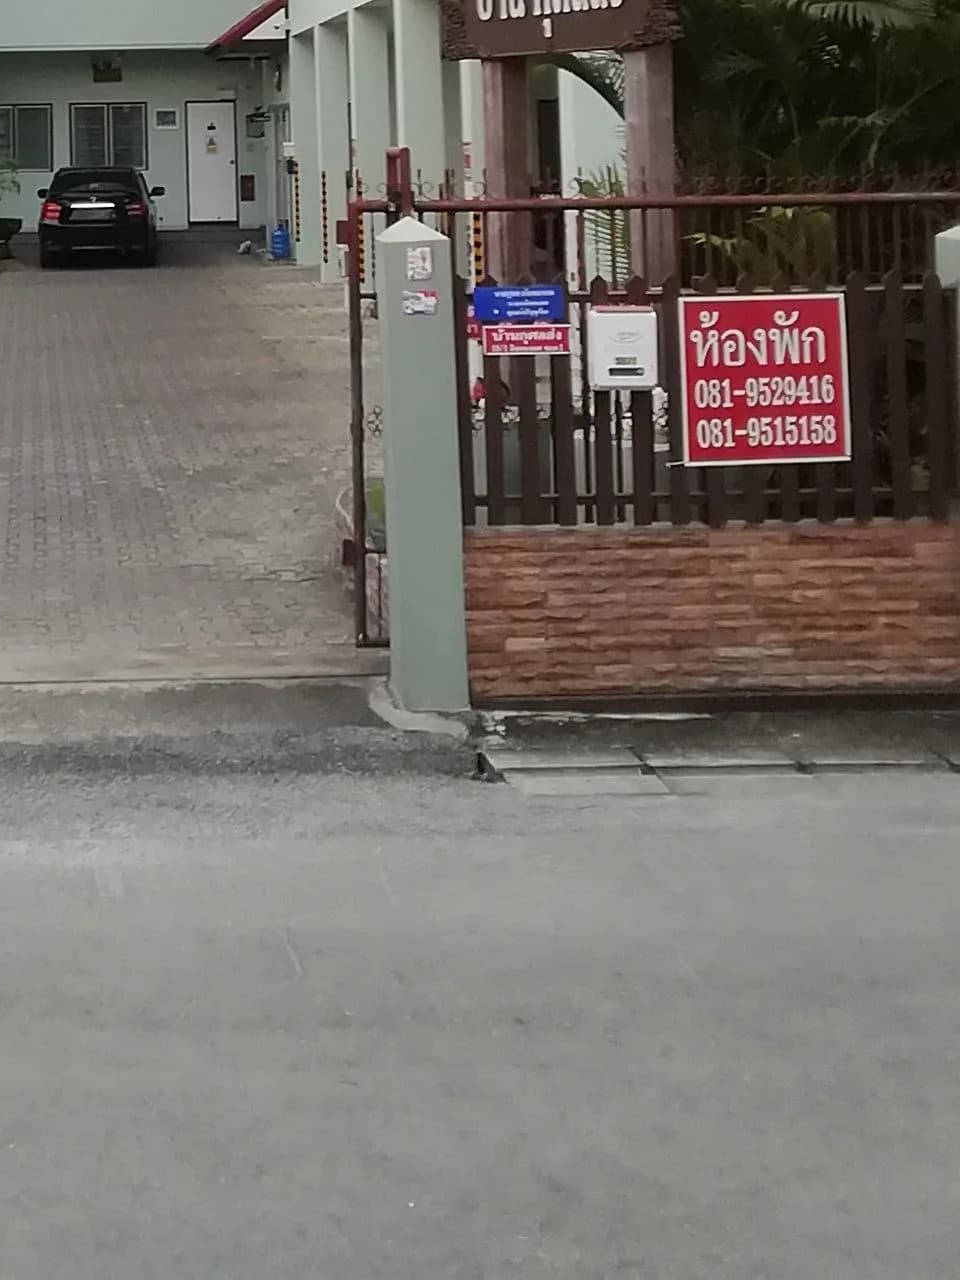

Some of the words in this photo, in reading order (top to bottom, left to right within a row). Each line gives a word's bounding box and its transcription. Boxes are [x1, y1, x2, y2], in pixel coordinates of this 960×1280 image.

[690, 310, 826, 367] ห้องพัก
[694, 375, 835, 408] 081-9529416
[696, 415, 837, 448] 081-9515158
